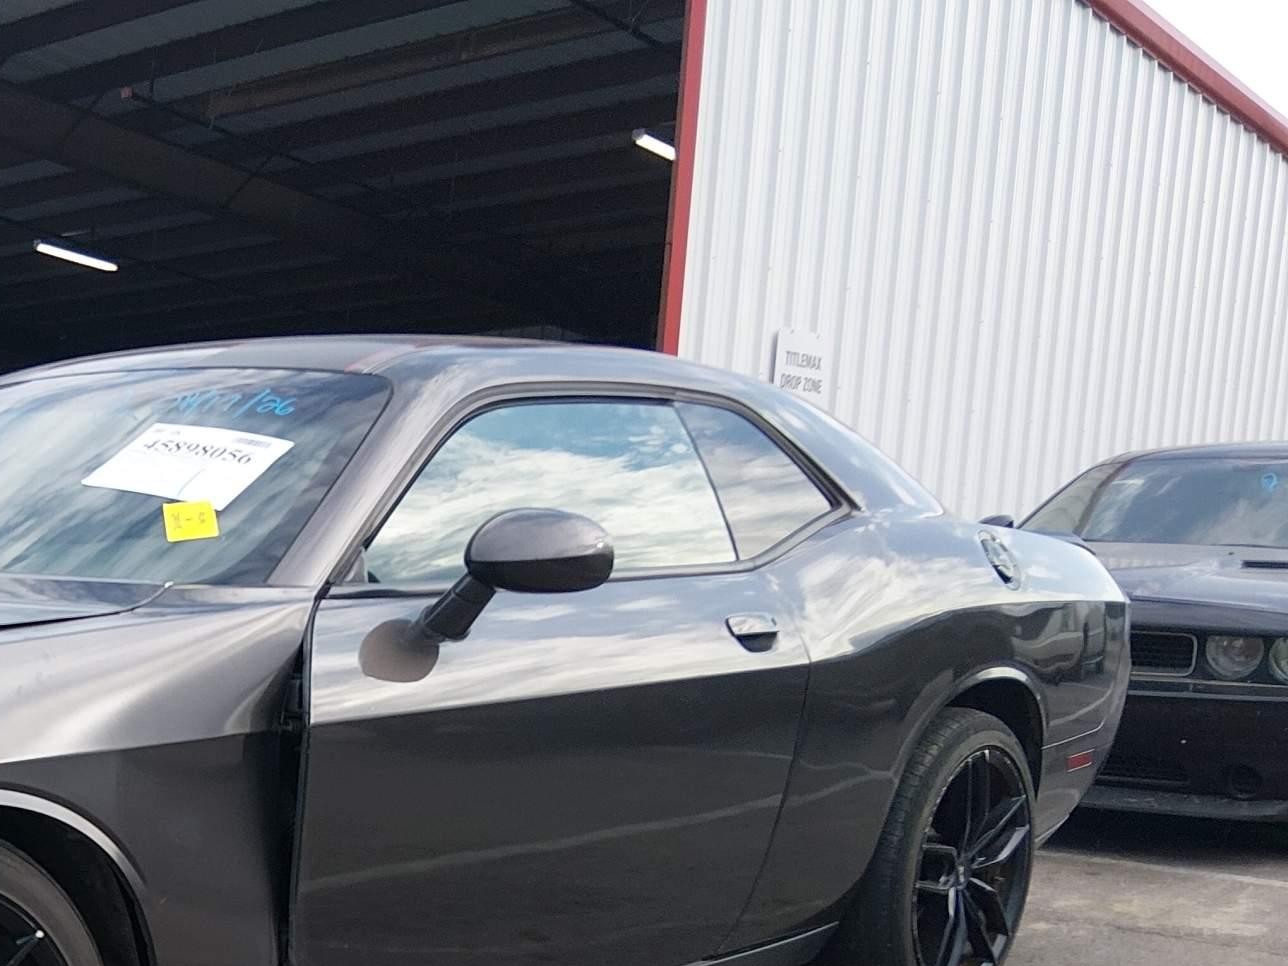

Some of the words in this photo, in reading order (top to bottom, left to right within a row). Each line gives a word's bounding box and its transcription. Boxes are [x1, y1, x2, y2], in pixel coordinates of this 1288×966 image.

[784, 350, 822, 370] TITLEMAX
[780, 373, 802, 391] DROP
[803, 376, 823, 394] ZONE
[144, 438, 255, 466] 45898056
